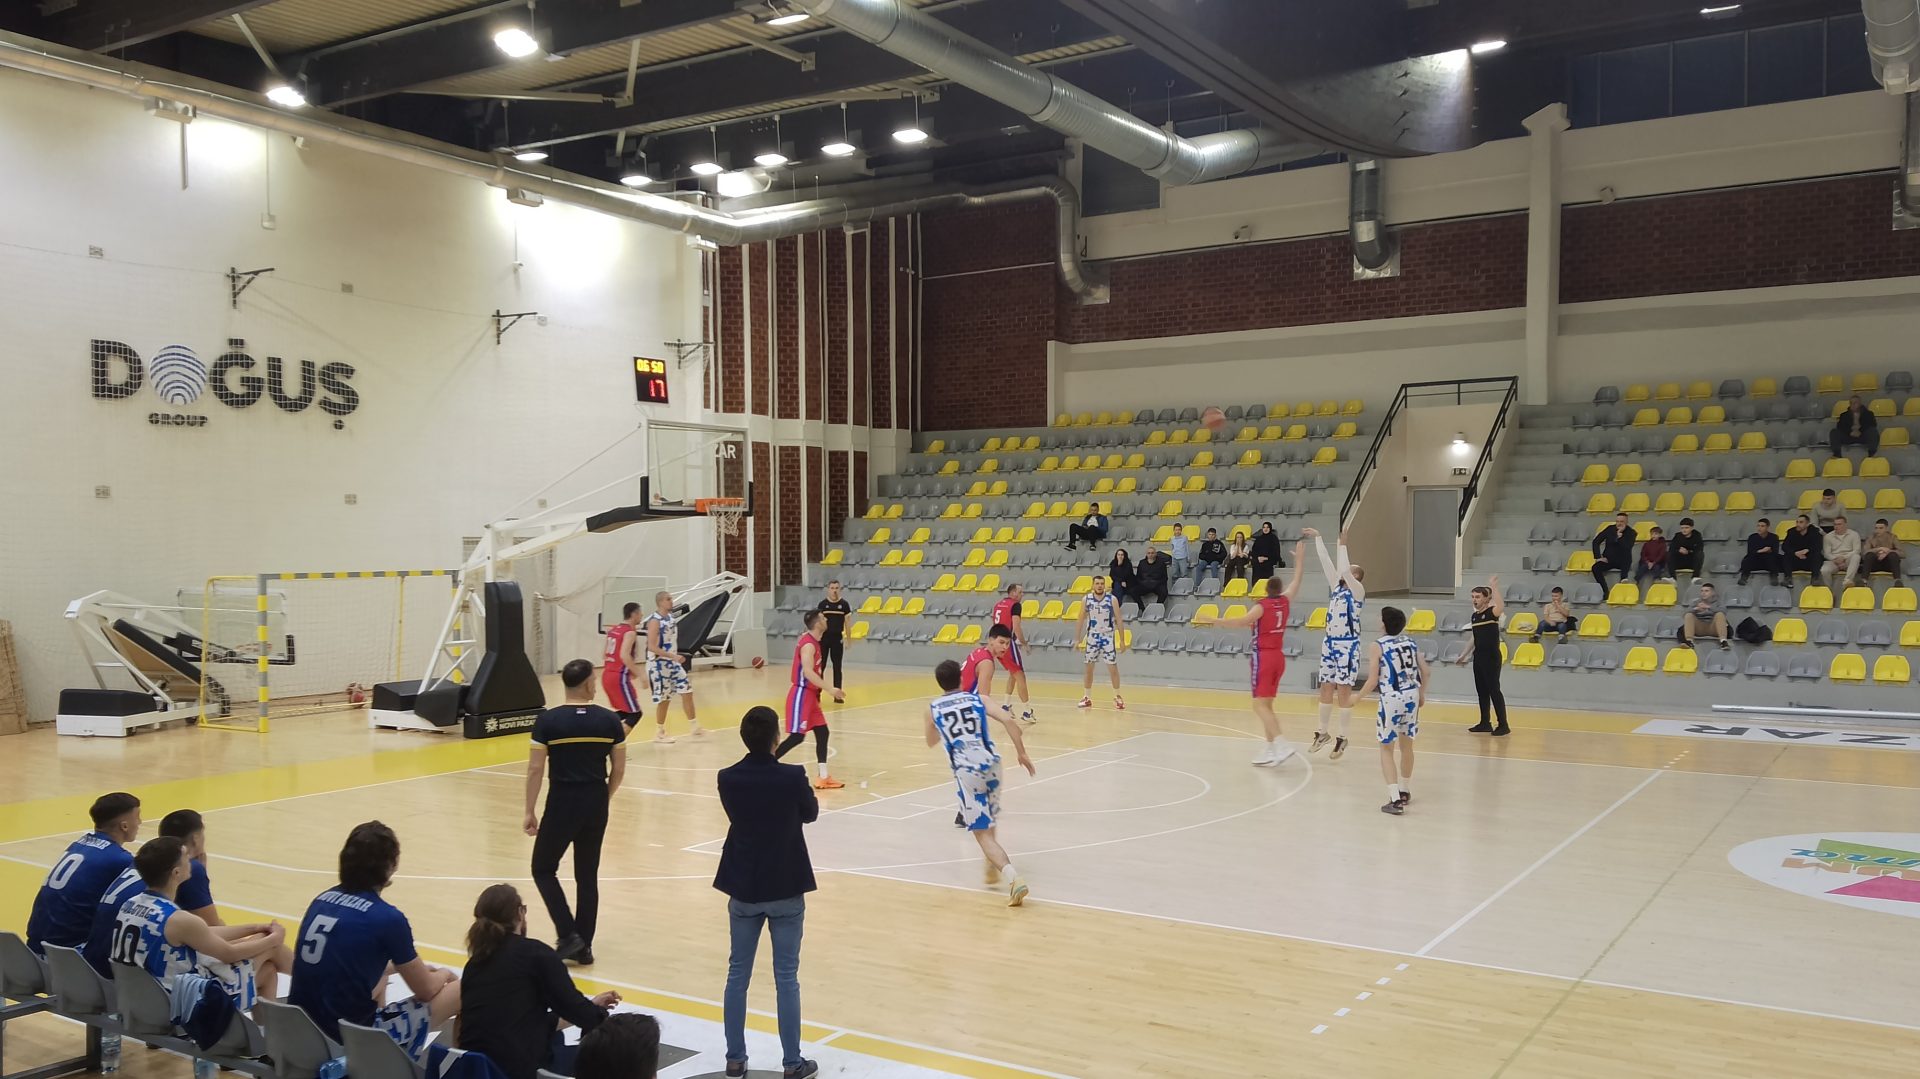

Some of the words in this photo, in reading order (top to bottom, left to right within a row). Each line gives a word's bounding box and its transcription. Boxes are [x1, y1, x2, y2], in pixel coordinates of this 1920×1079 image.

[648, 379, 666, 398] 17
[148, 412, 208, 427] GROUP
[994, 609, 1002, 624] 5
[1394, 646, 1413, 669] 13
[943, 706, 977, 739] 25
[335, 893, 374, 913] PAZAR
[300, 914, 340, 965] 5
